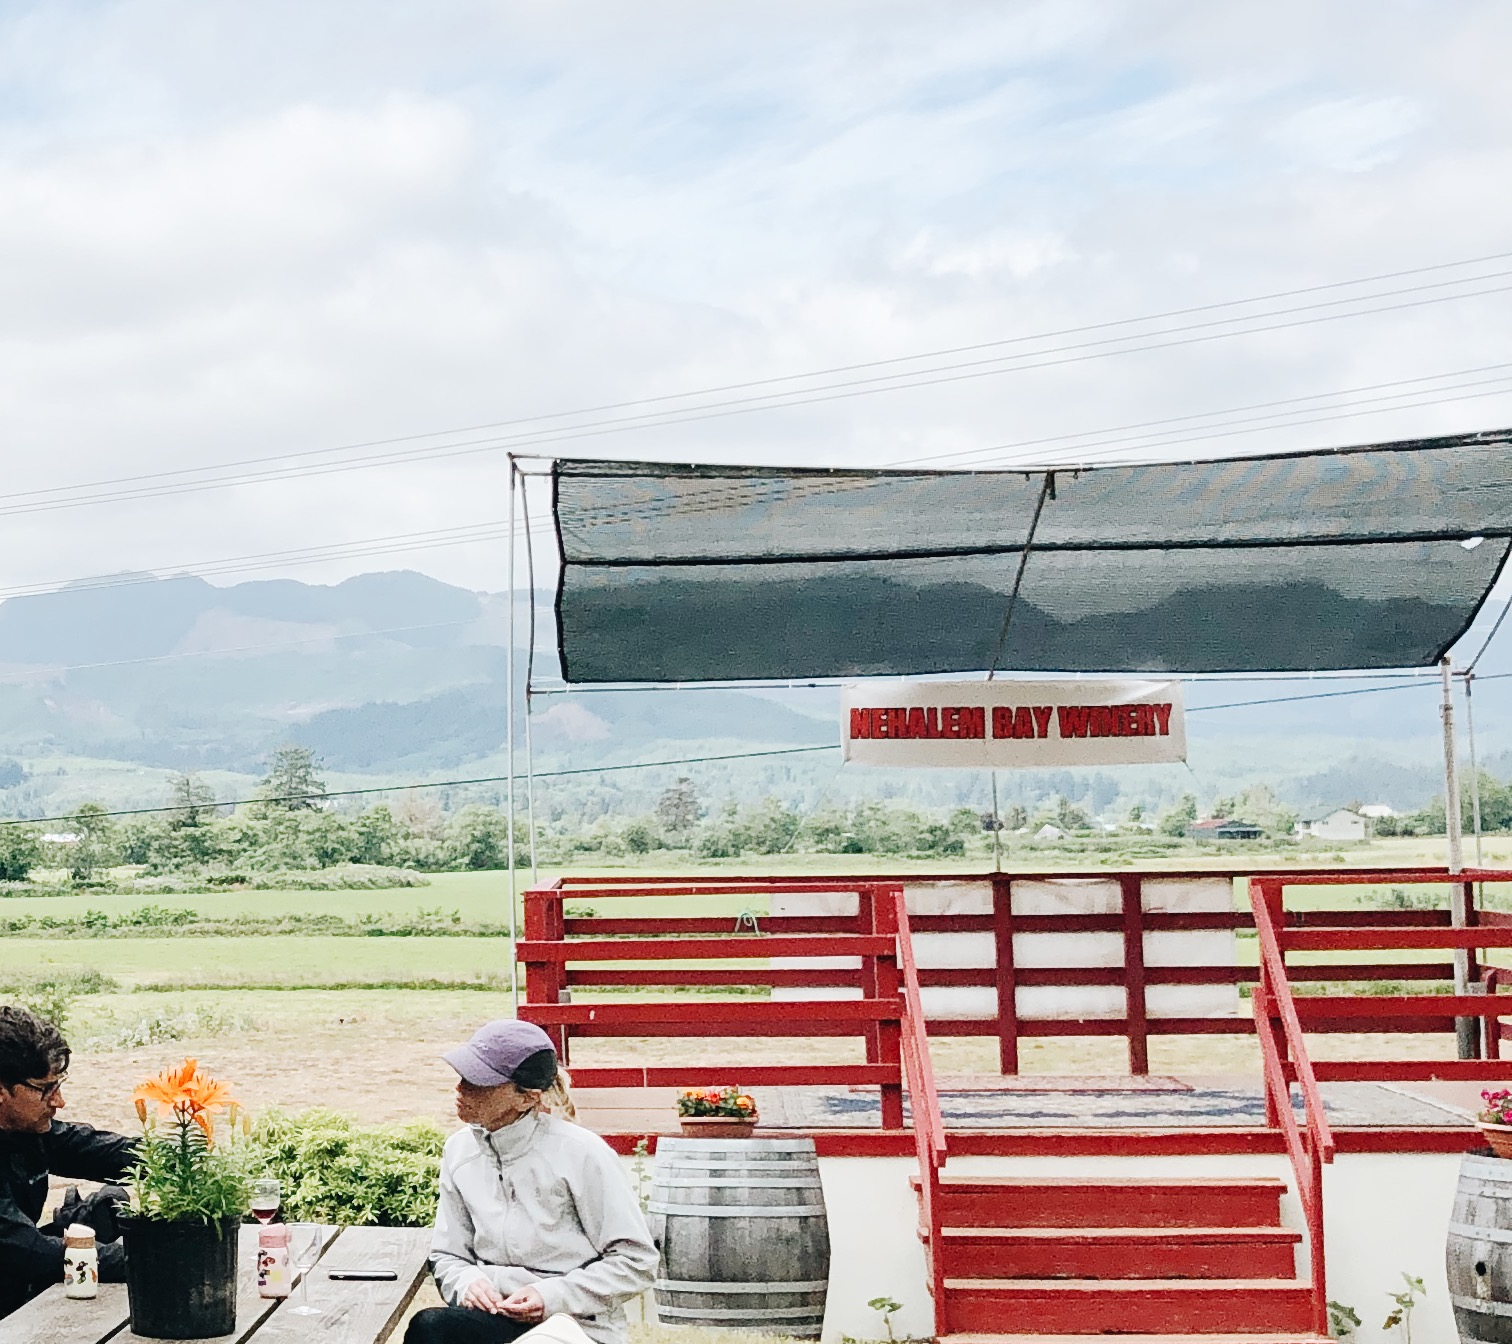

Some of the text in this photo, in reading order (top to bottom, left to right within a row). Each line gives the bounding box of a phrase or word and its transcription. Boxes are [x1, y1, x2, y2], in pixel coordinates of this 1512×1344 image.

[850, 703, 1172, 739] NEHALEM BAY WINERY
